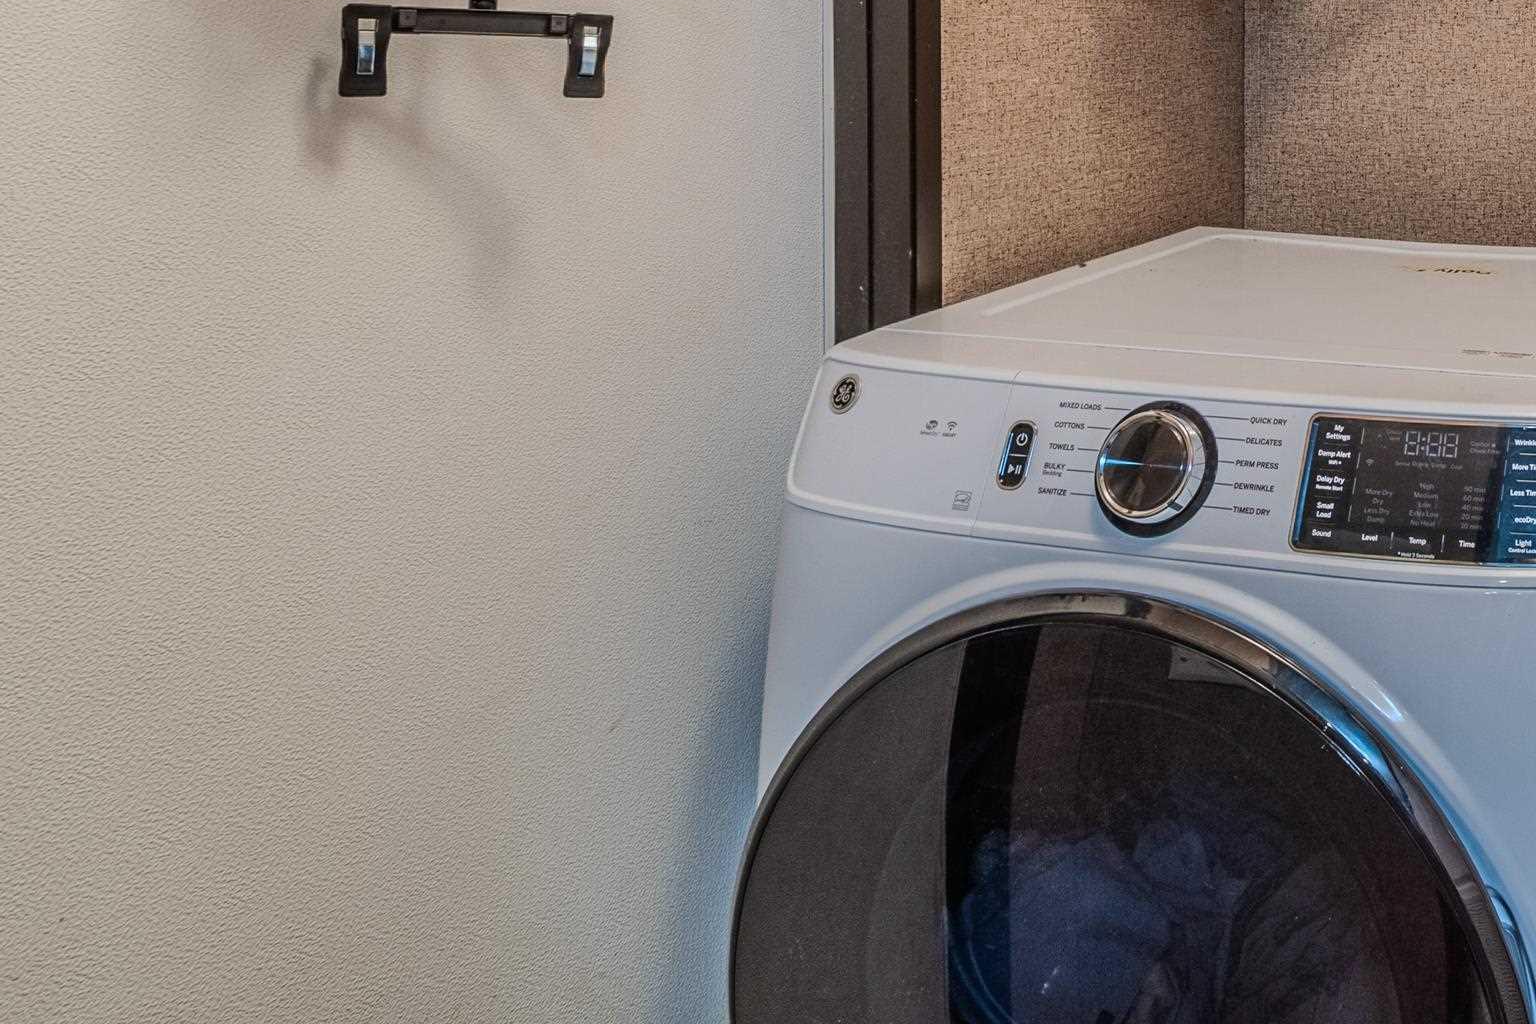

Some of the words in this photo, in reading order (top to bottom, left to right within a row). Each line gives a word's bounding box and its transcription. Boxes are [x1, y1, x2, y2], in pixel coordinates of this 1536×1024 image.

[1059, 401, 1080, 409] MIXED
[1080, 403, 1102, 411] LOADS
[1054, 421, 1086, 429] COTTONS
[1249, 416, 1272, 425] QUICK
[1273, 418, 1288, 426] DRY
[1333, 424, 1344, 432] My
[1325, 432, 1351, 441] Settings
[1049, 442, 1075, 451] TOWELS
[1245, 437, 1282, 447] DELICATES
[1317, 449, 1335, 459] Damp
[1336, 450, 1352, 458] Alert
[1235, 459, 1255, 468] PERM
[1256, 461, 1279, 470] PRESS
[1511, 463, 1529, 471] More
[1316, 475, 1333, 485] Delay
[1333, 476, 1346, 486] Dry
[1038, 487, 1068, 496] SANITIZE
[1233, 482, 1275, 492] DEWRINKLE
[1316, 501, 1335, 509] Small
[1233, 506, 1255, 515] TIMED
[1255, 508, 1271, 516] DRY
[1311, 529, 1332, 538] Sound
[1361, 533, 1379, 542] Level
[1408, 537, 1427, 546] Temp
[1459, 540, 1476, 548] Time
[1515, 539, 1533, 548] Light
